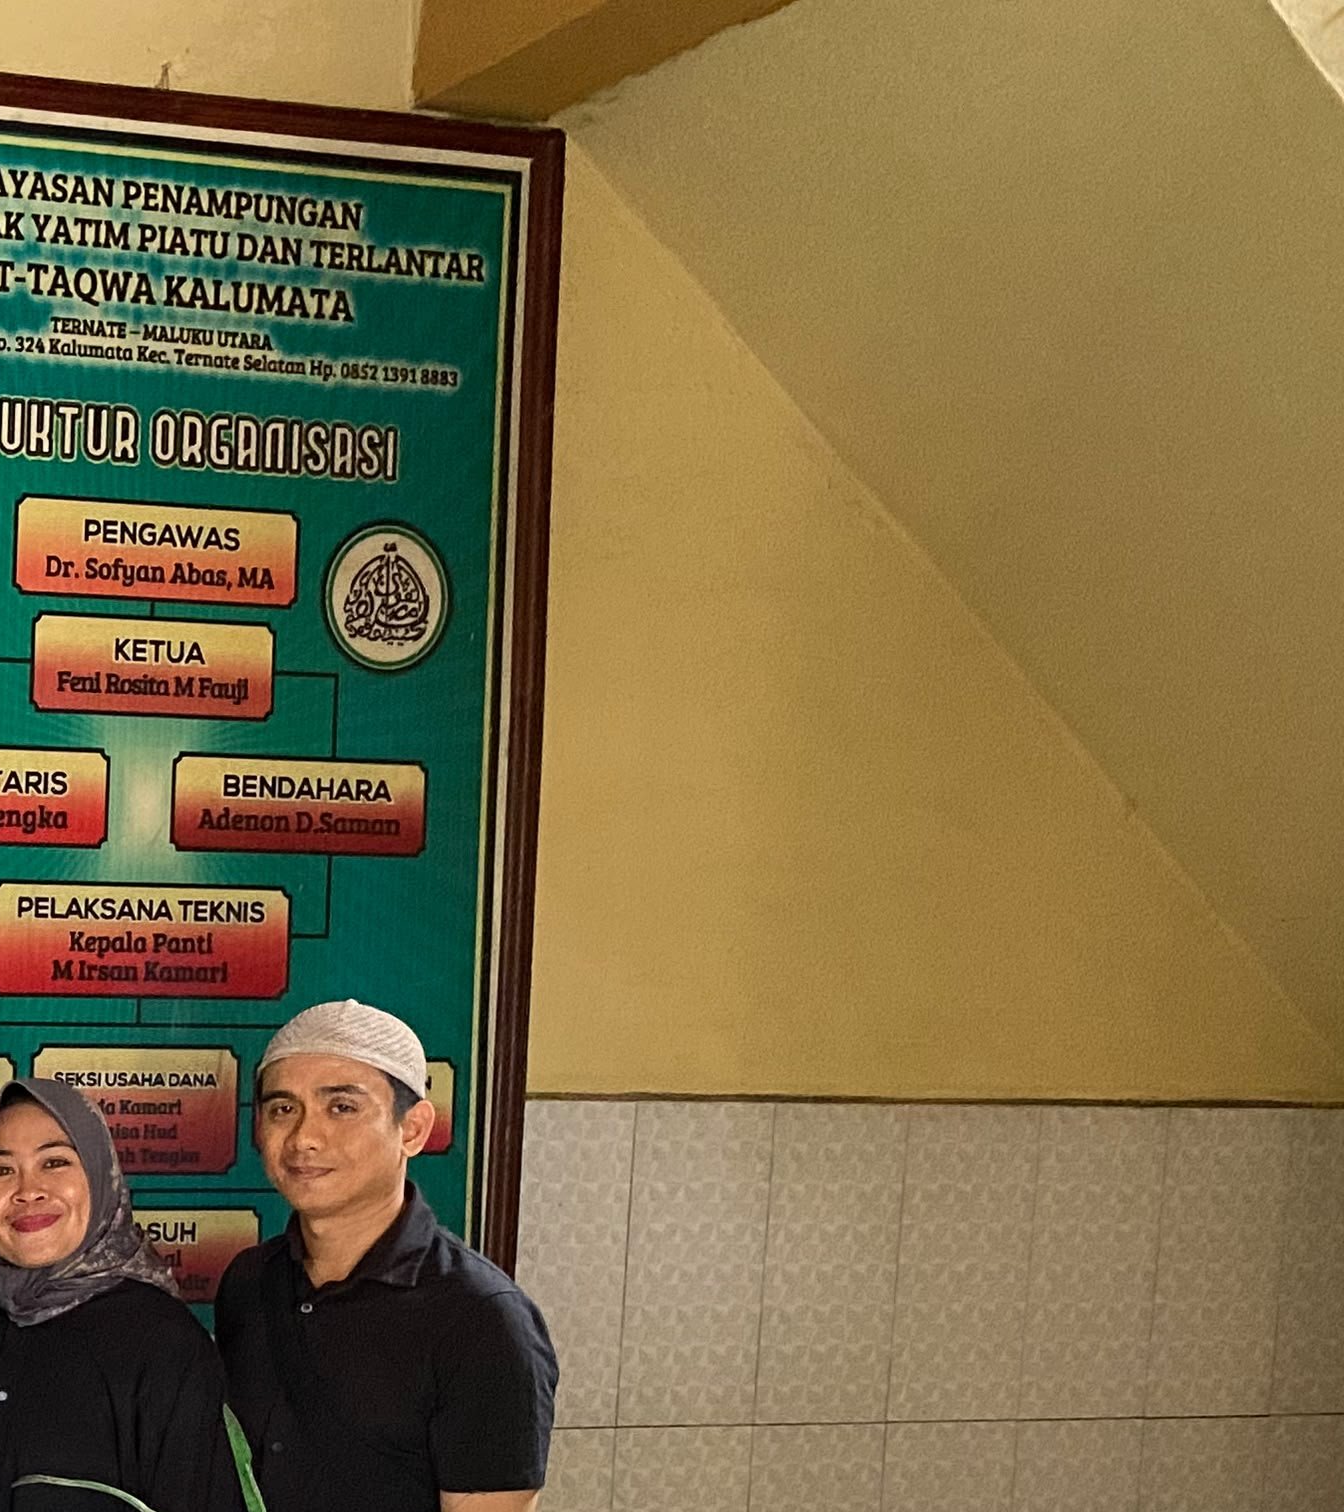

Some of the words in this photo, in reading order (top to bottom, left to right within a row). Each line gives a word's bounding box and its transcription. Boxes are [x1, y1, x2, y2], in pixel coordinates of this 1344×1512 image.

[122, 179, 364, 232] PENAMPUNGAN
[31, 213, 130, 251] YATIM
[137, 223, 230, 260] PIATU
[237, 232, 303, 267] DAN
[309, 239, 485, 283] TERLANTAR
[163, 274, 355, 323] KALUMATA
[50, 315, 127, 339] TERNATE
[142, 323, 213, 346] MALUKU
[217, 333, 273, 352] UTARA
[15, 336, 45, 355] 324
[48, 337, 133, 362] Kalumata
[136, 344, 170, 365] Kec.
[174, 348, 239, 370] Ternate
[243, 354, 305, 376] Selatan
[309, 359, 336, 382] Hp.
[340, 362, 378, 382] 0852
[152, 409, 399, 481] ORGANISASI
[83, 518, 241, 551] PENGAWAS
[45, 555, 80, 579] Dr.
[84, 557, 165, 587] Sofyan
[169, 562, 233, 591] Abas,
[237, 566, 275, 590] MA
[114, 637, 206, 665] KETUA
[173, 676, 194, 698] M
[222, 773, 393, 803] BENDAHARA
[17, 895, 173, 922] PELAKSANA
[178, 899, 266, 923] TEKNIS
[68, 930, 147, 959] Kepala
[152, 931, 213, 955] Panti
[51, 959, 74, 982] M
[54, 1071, 102, 1087] SEKSI
[104, 1072, 165, 1087] USAHA
[168, 1073, 217, 1088] DANA
